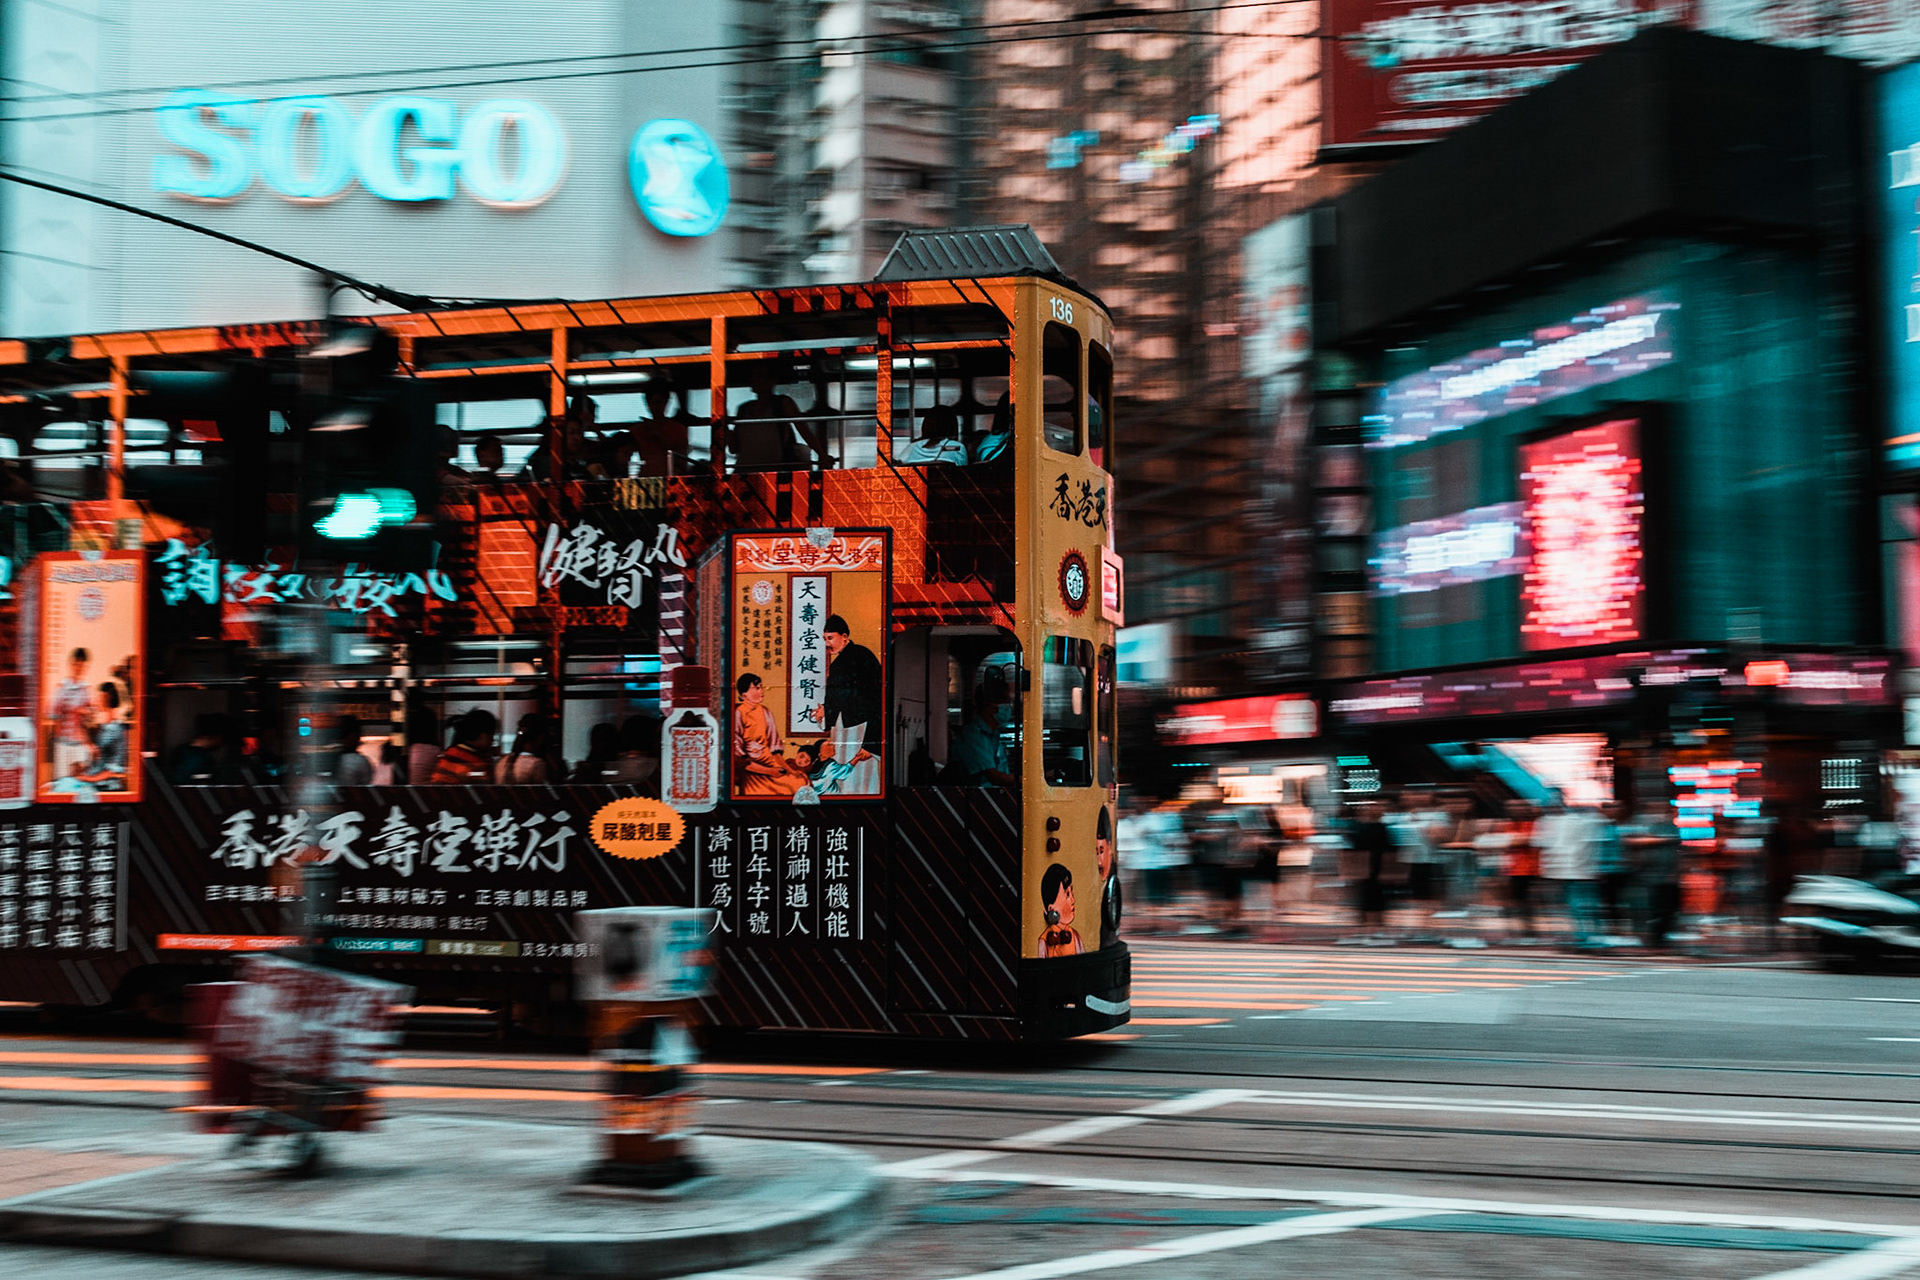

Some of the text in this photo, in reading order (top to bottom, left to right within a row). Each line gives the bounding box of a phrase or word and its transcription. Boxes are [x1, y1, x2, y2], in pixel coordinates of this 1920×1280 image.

[153, 88, 570, 209] SOGO
[1049, 296, 1074, 325] 136
[797, 580, 822, 724] 天壽堂健腎丸
[602, 822, 672, 841] 尿酸剋星
[746, 825, 772, 935] 百年字號
[785, 825, 811, 935] 精神過人
[823, 826, 851, 938] 強壯機能
